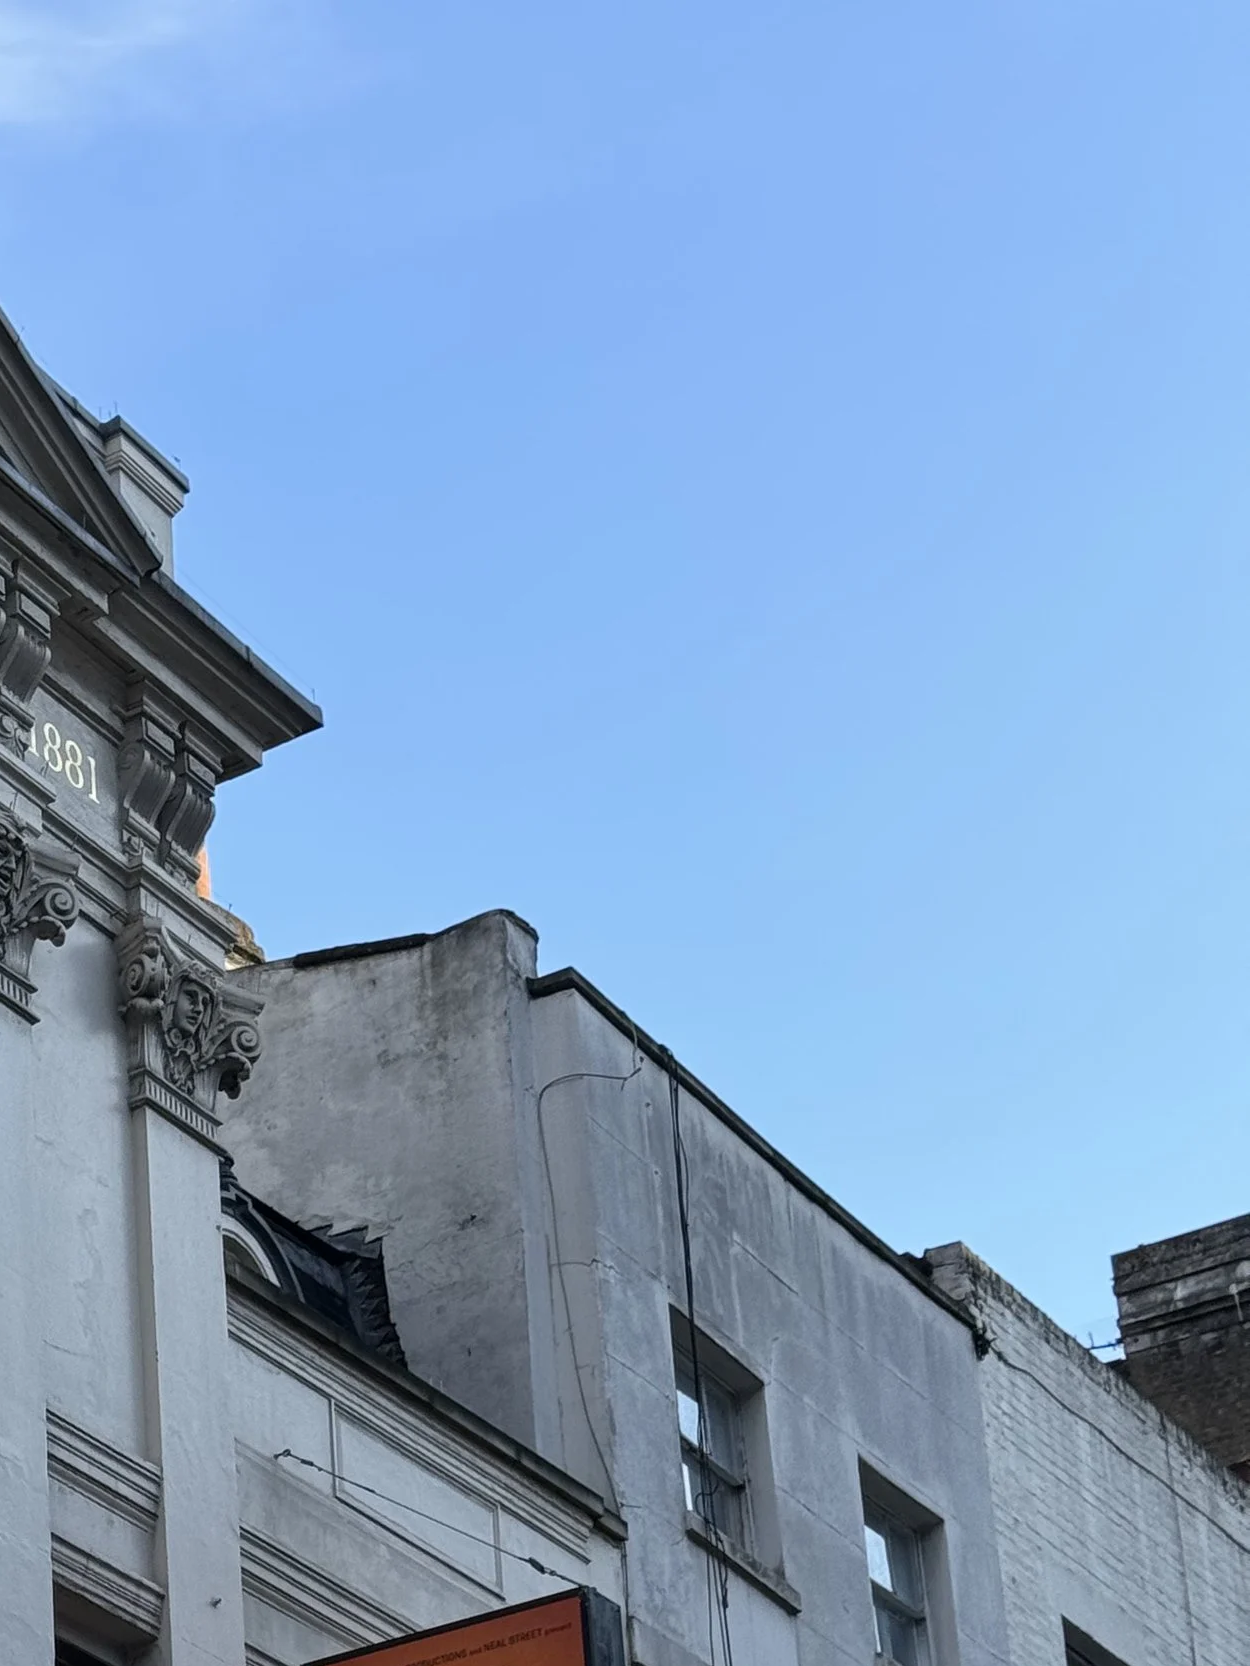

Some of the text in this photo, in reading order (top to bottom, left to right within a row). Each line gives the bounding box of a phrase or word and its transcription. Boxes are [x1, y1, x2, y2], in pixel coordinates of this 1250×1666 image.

[29, 722, 101, 804] 1881
[484, 1638, 507, 1651] NEAL
[508, 1628, 542, 1645] STREET
